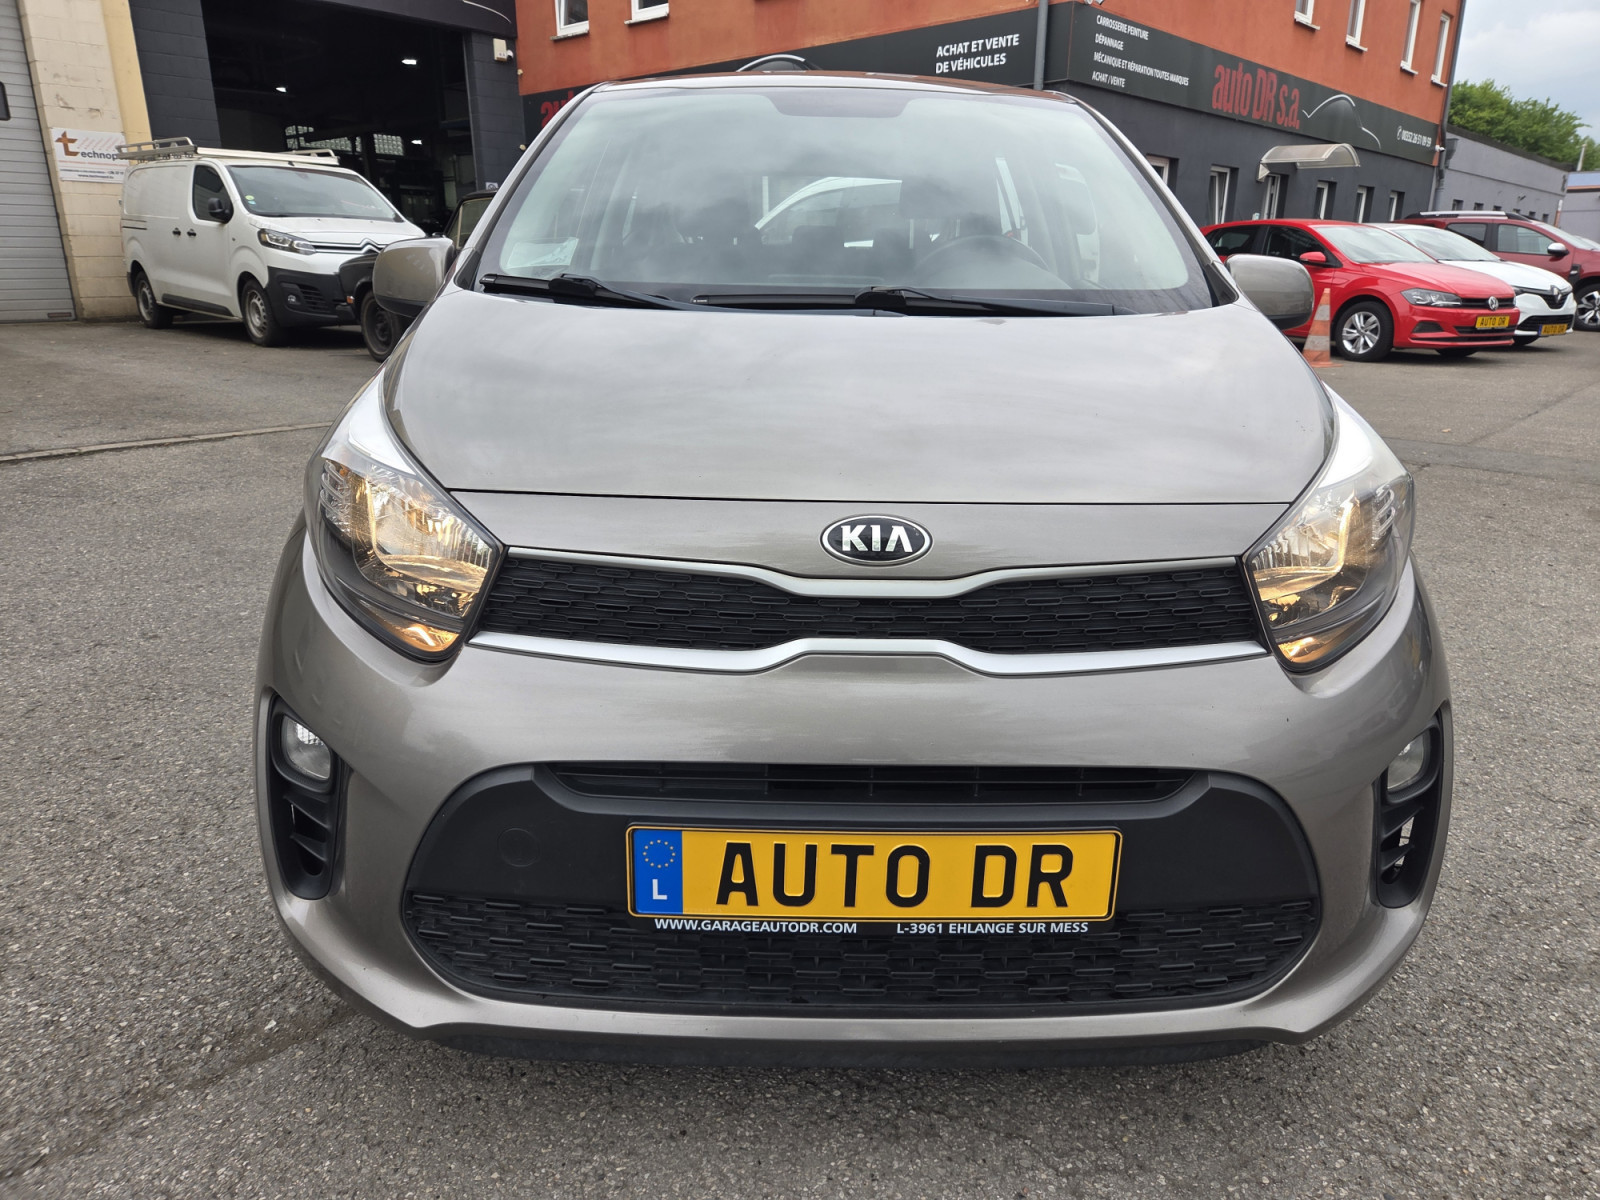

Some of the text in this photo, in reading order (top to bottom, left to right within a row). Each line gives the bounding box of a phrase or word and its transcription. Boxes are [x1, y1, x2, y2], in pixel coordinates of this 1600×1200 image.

[1096, 15, 1149, 40] CARROSSERIE PEINTURE
[936, 34, 1019, 57] ACHAT ET VENTE
[1095, 33, 1124, 50] DÉPANNAGE
[935, 53, 1006, 74] DE VÉHICULES
[1094, 51, 1121, 68] MÉCANIQUE
[1121, 60, 1127, 69] ET
[1127, 61, 1153, 77] RÉPARATION
[1169, 73, 1189, 86] MARQUES
[1092, 71, 1108, 83] ACHAT
[1111, 76, 1125, 87] VENTE
[1212, 62, 1252, 117] auto
[1252, 68, 1277, 123] DR
[840, 525, 913, 553] KIA
[715, 840, 1074, 908] AUTO DR
[652, 878, 668, 900] L
[654, 918, 857, 934] WWW.GARAGEAUTODR.COM
[896, 922, 1089, 934] L-3961 EHLANGE SUR MESS
